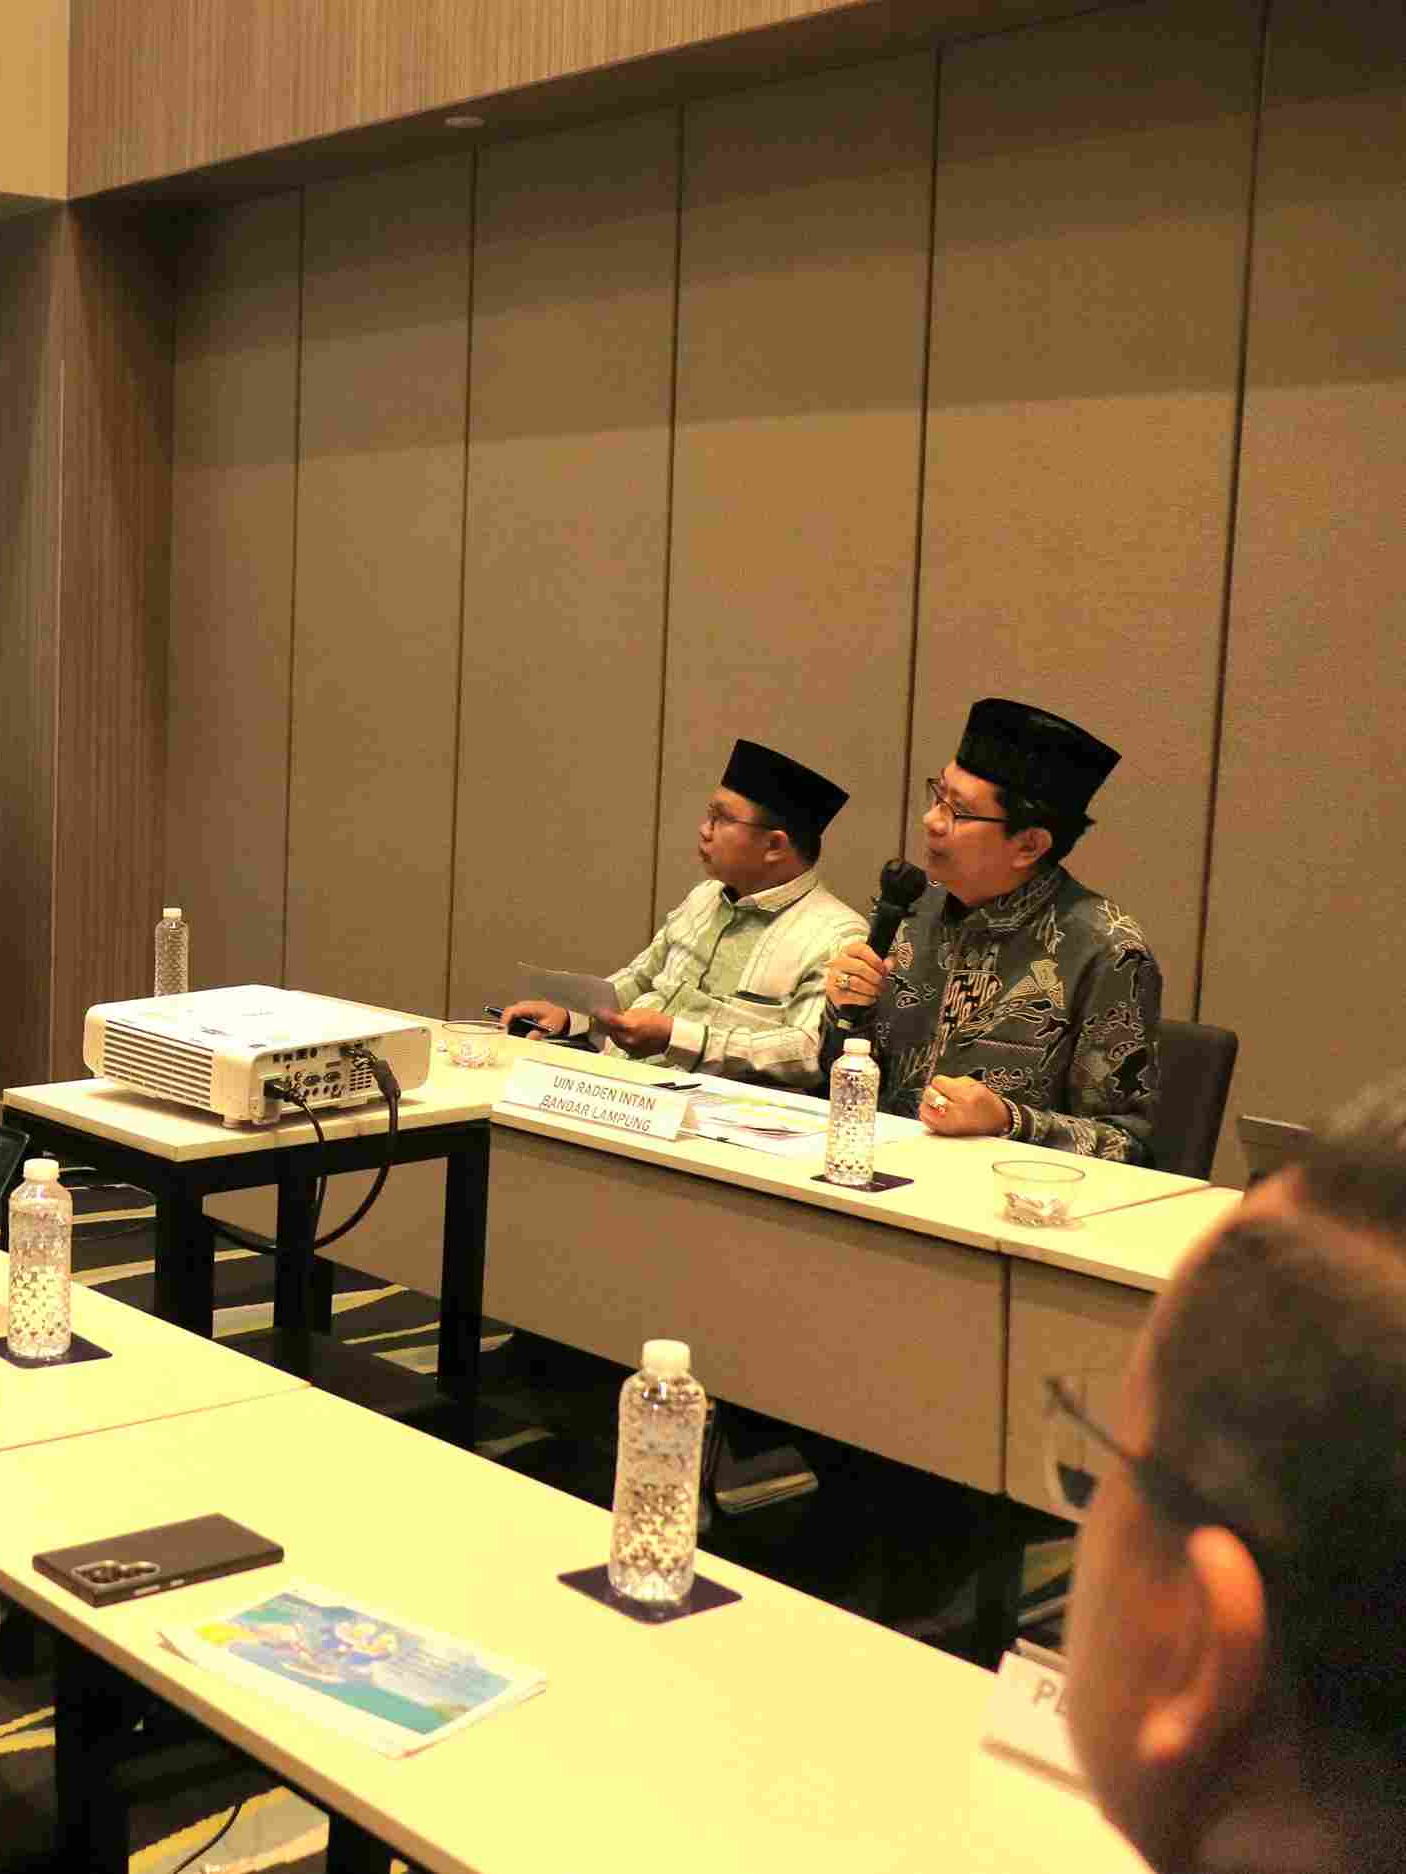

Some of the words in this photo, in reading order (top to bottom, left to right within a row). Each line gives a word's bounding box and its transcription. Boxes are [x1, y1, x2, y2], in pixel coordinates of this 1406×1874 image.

[553, 1075, 574, 1091] UIN
[576, 1081, 616, 1102] RADEN
[618, 1092, 656, 1111] INTAN
[540, 1094, 590, 1117] BANDAR
[592, 1107, 652, 1132] LAMPUNG
